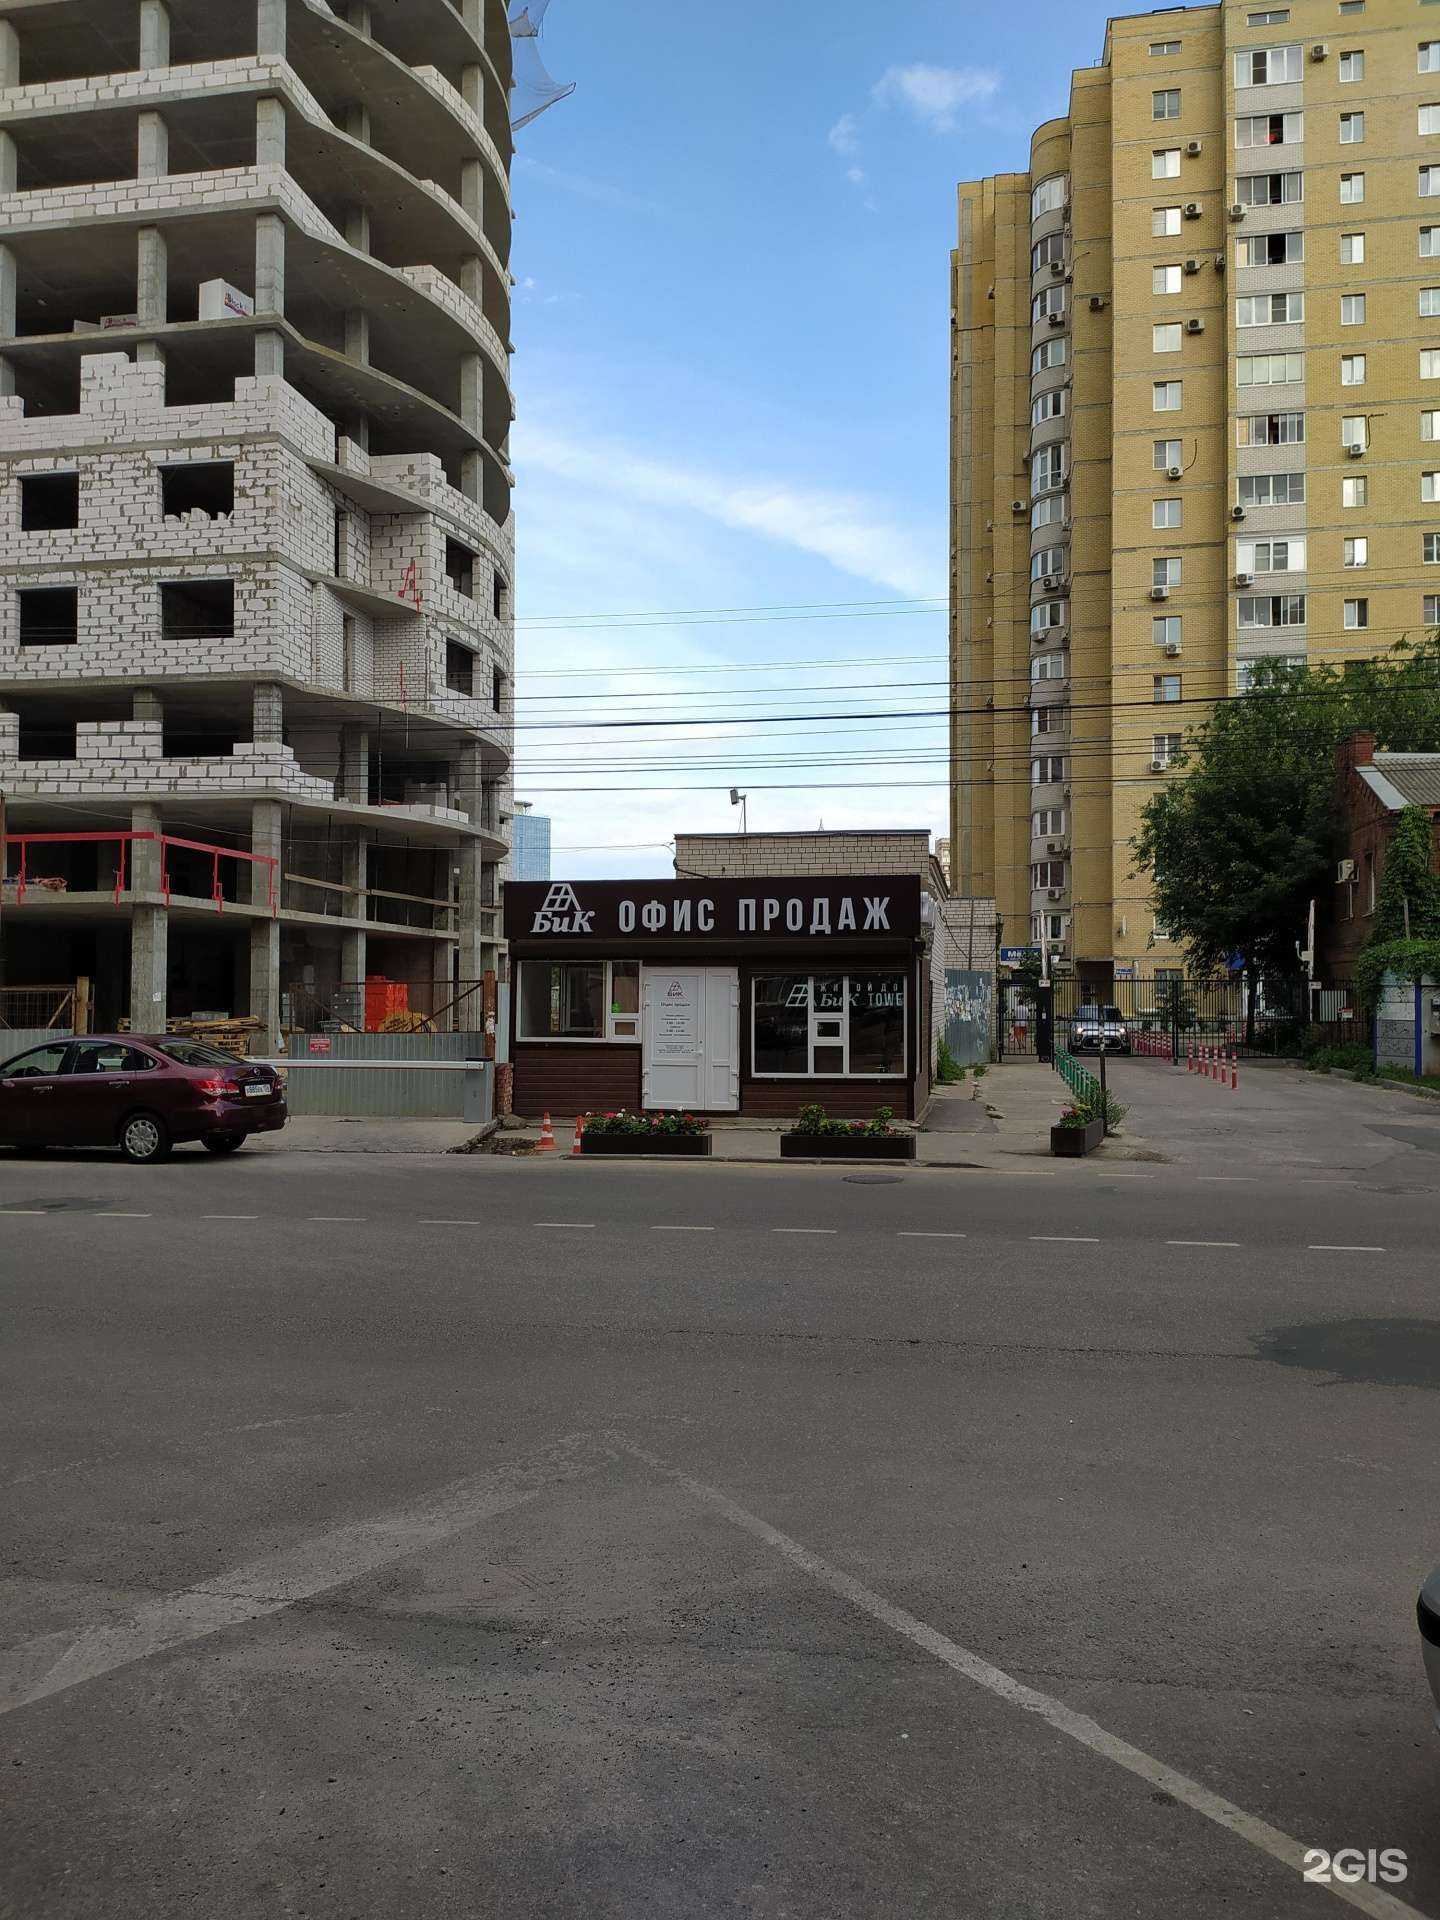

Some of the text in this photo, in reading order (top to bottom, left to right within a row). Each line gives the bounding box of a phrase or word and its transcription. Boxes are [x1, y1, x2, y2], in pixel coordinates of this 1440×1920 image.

[530, 910, 596, 933] БиК
[618, 897, 890, 934] ОФИС ПРОДАЖ
[820, 982, 873, 992] ЖИОЙ
[868, 992, 904, 1006] TOWE
